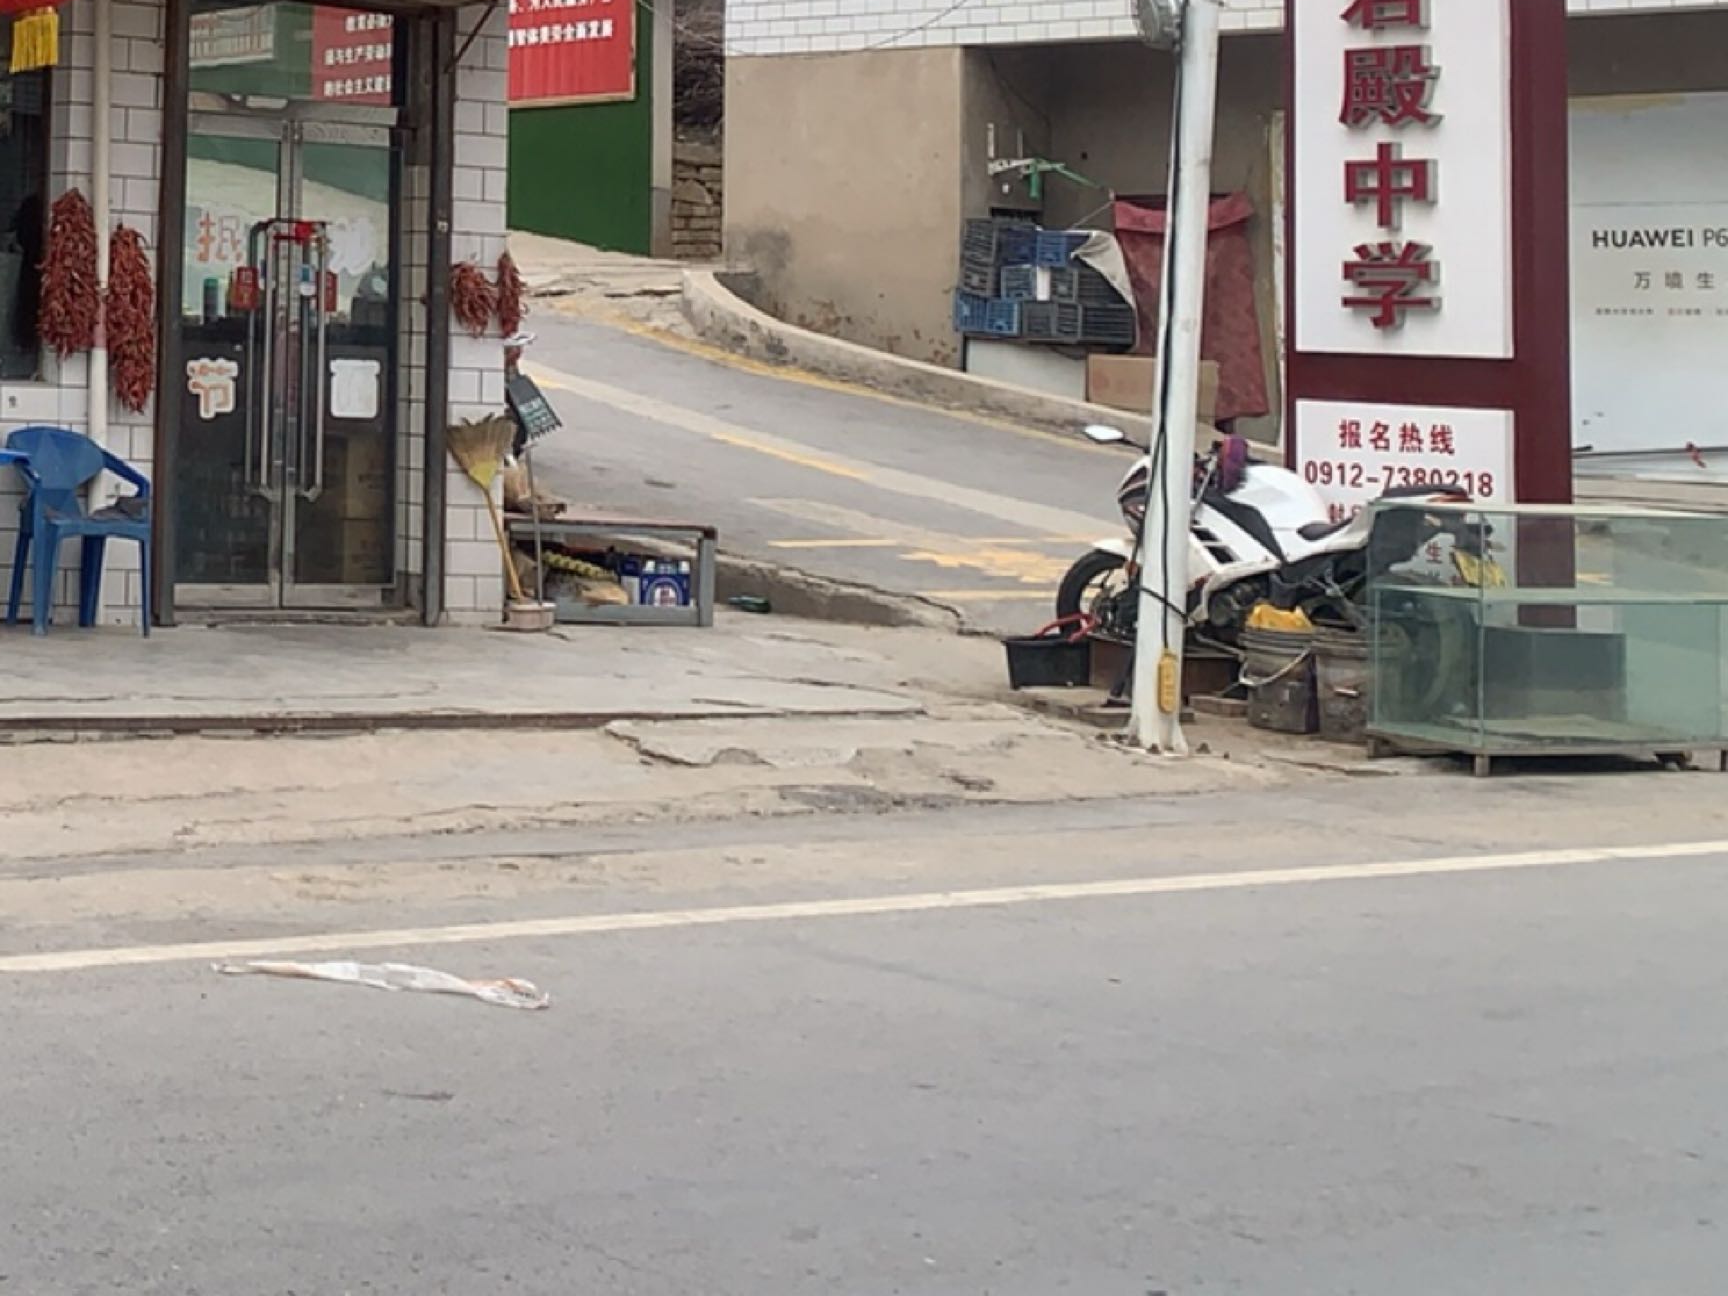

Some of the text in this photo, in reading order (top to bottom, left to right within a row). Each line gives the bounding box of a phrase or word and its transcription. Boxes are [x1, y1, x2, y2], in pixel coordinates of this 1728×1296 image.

[1592, 229, 1694, 248] HUAWEI
[1338, 419, 1455, 454] 报名热线
